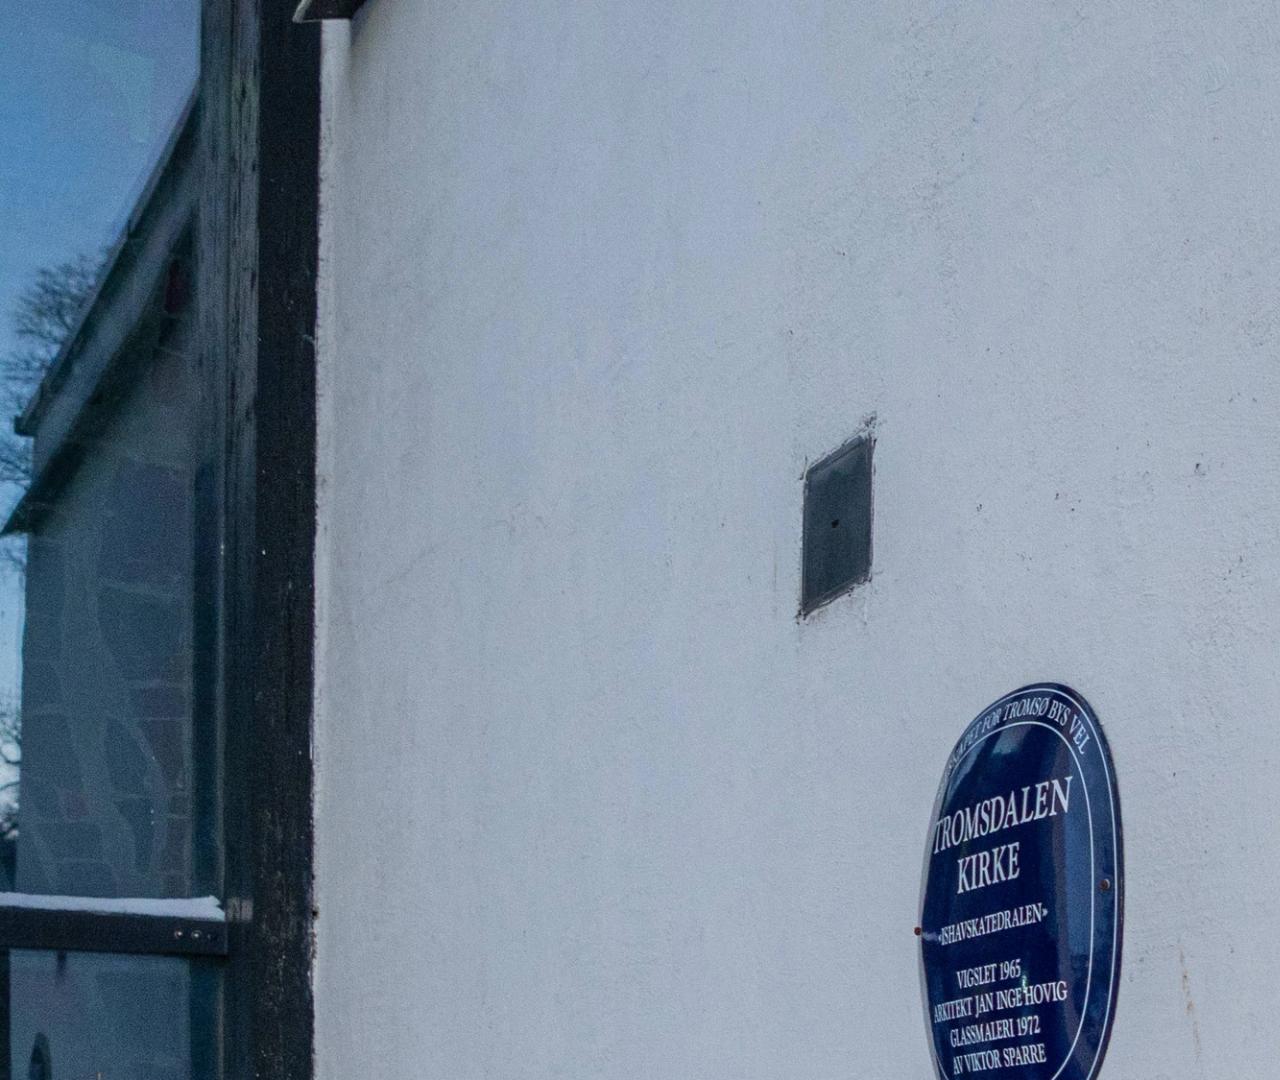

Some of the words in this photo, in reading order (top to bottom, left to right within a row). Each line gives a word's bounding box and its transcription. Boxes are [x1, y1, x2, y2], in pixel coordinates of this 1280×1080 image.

[983, 709, 1002, 732] FOR
[1003, 697, 1050, 721] TROMSØ
[1048, 699, 1071, 726] BYS
[1068, 713, 1091, 754] VEL
[933, 776, 1073, 855] TROMSDALEN
[957, 842, 1020, 894] KIRKE
[957, 963, 997, 989] VIGSLET
[1000, 958, 1022, 981] 1965
[934, 997, 972, 1023] ARKITEKT
[974, 992, 994, 1018] JAN
[996, 988, 1022, 1011] INGE
[1024, 980, 1068, 1007] HOVIG
[950, 1018, 1015, 1048] GLASSMALERI
[1017, 1015, 1041, 1037] 1972
[953, 1057, 967, 1075] AV
[966, 1051, 1002, 1073] VIKTOR
[1003, 1043, 1047, 1068] SPARRE
